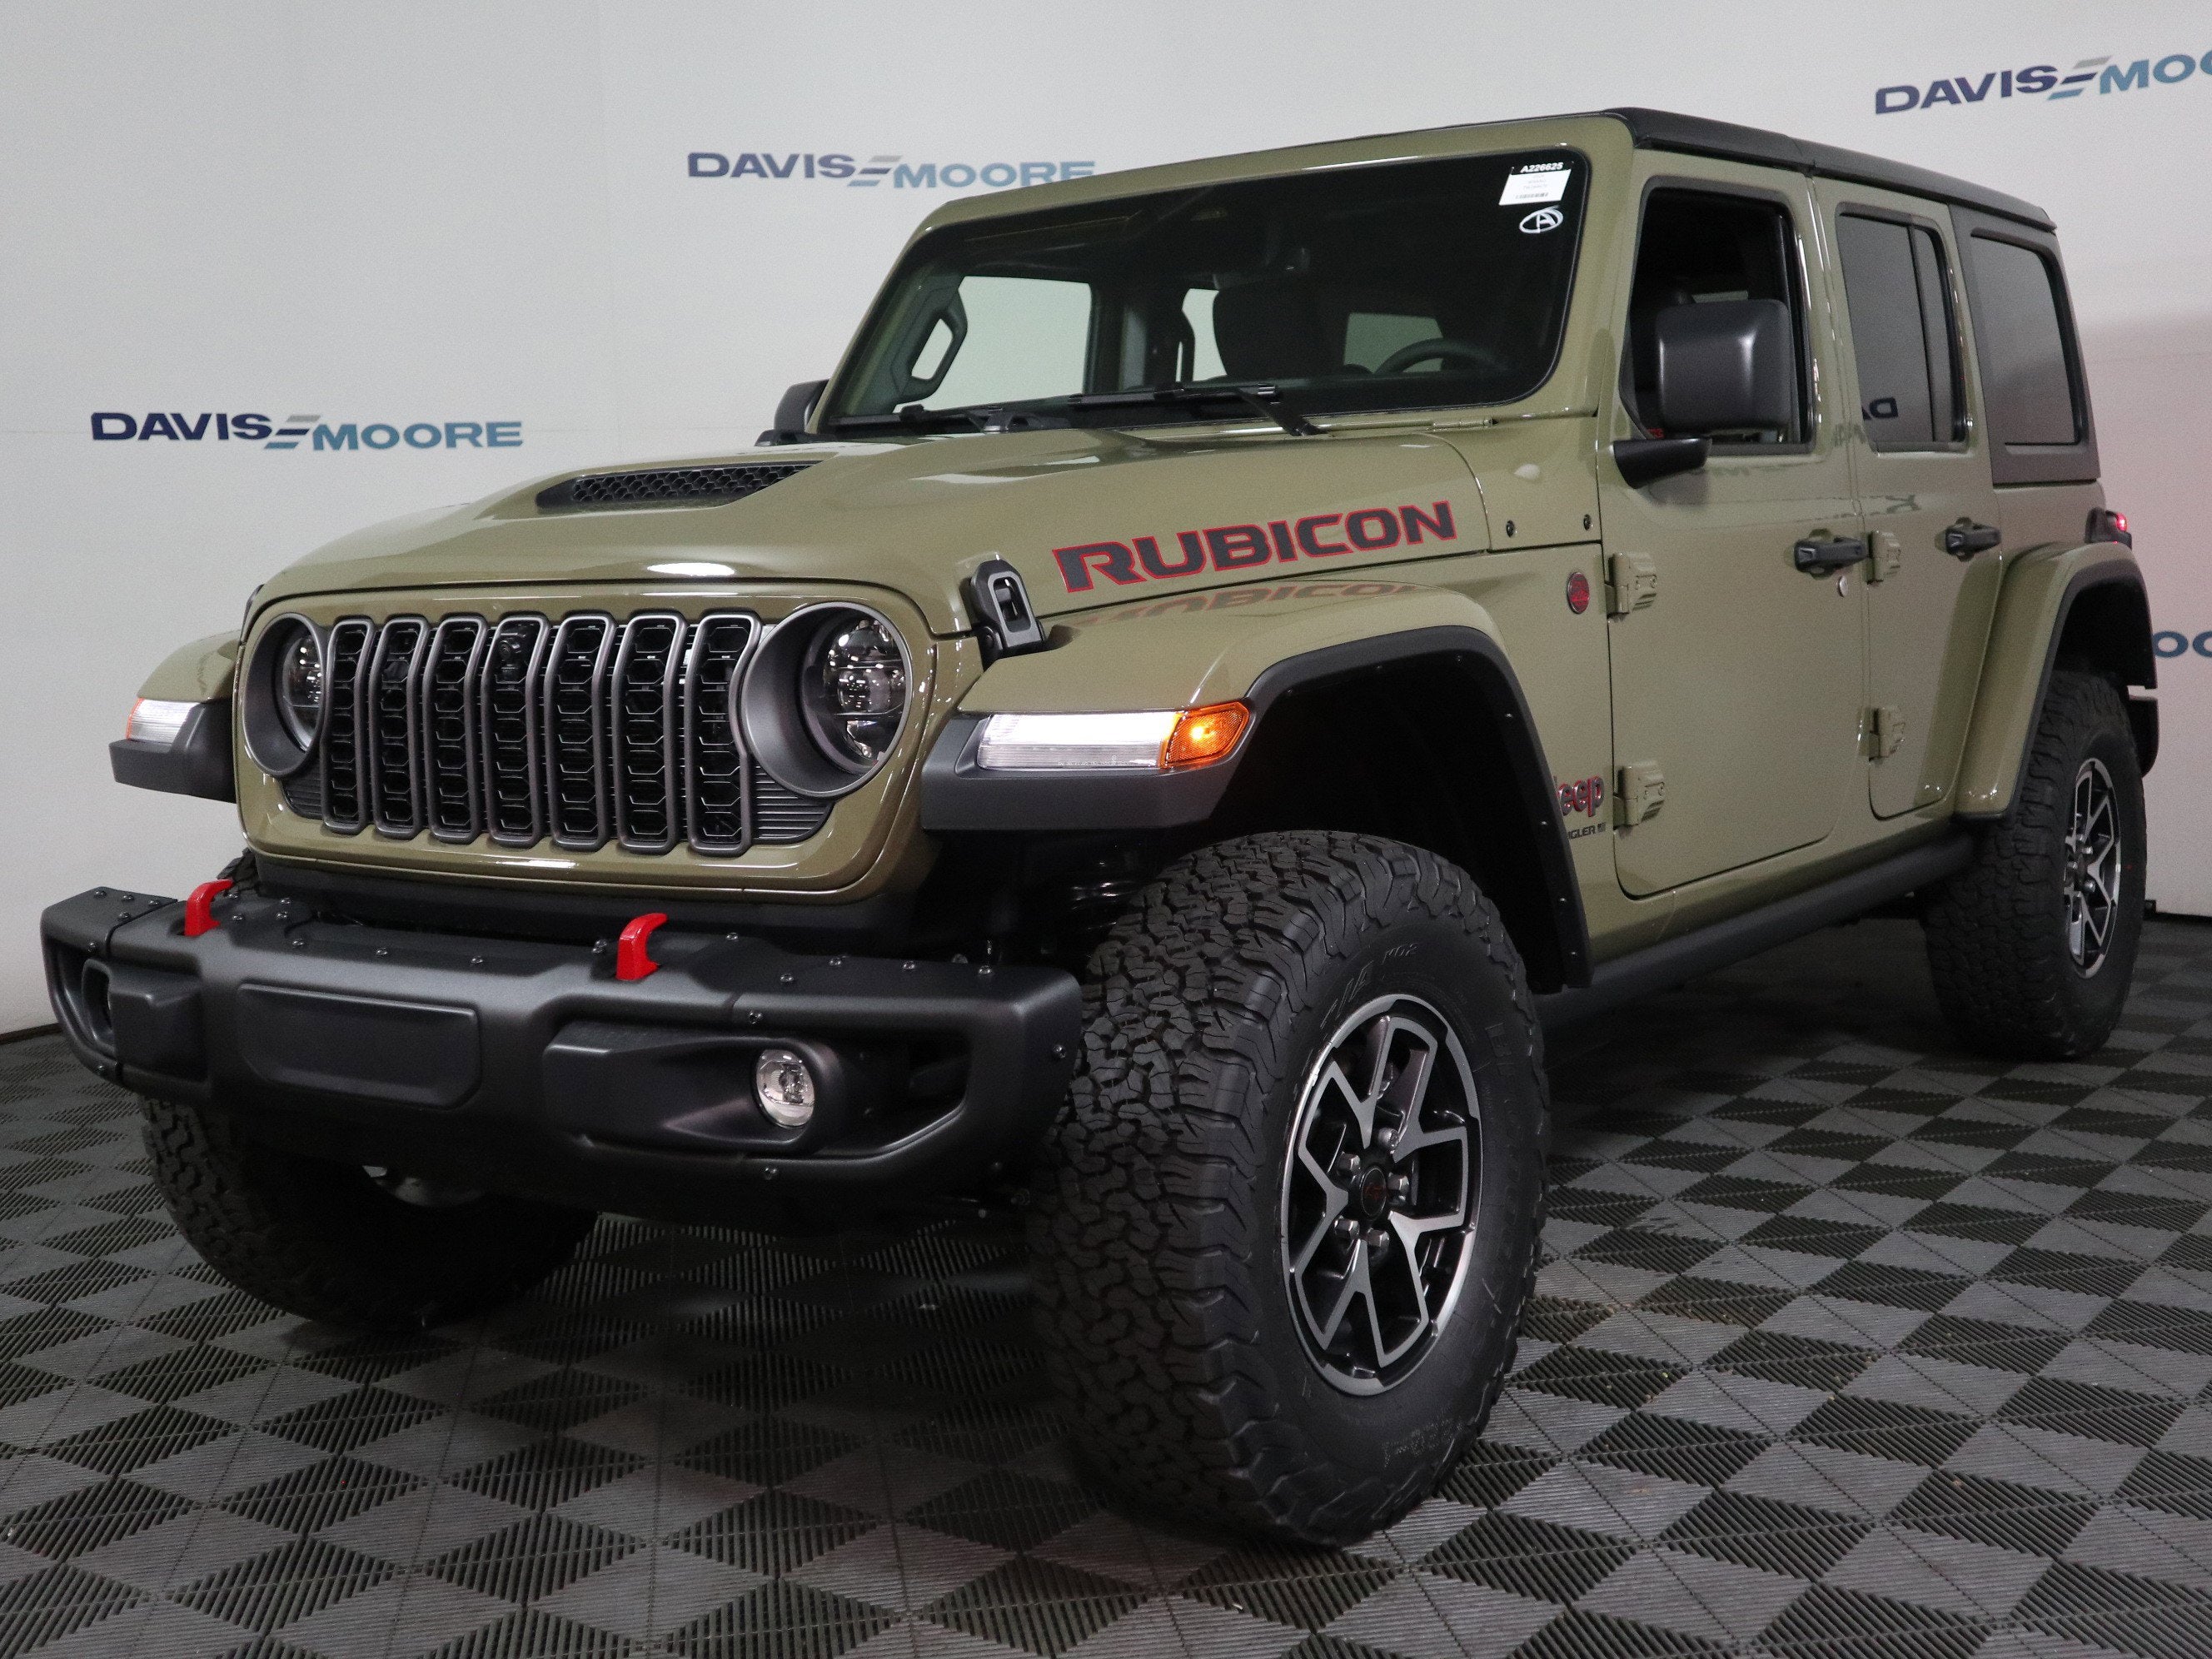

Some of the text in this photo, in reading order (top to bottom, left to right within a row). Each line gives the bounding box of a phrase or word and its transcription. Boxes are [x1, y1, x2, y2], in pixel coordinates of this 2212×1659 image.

[1875, 48, 2212, 115] DAVIS MO
[687, 152, 1096, 189] DAVIS MOORE
[91, 412, 523, 451] DAVIS MOORE
[1052, 500, 1457, 594] RUBICON
[1556, 774, 1605, 818] eep
